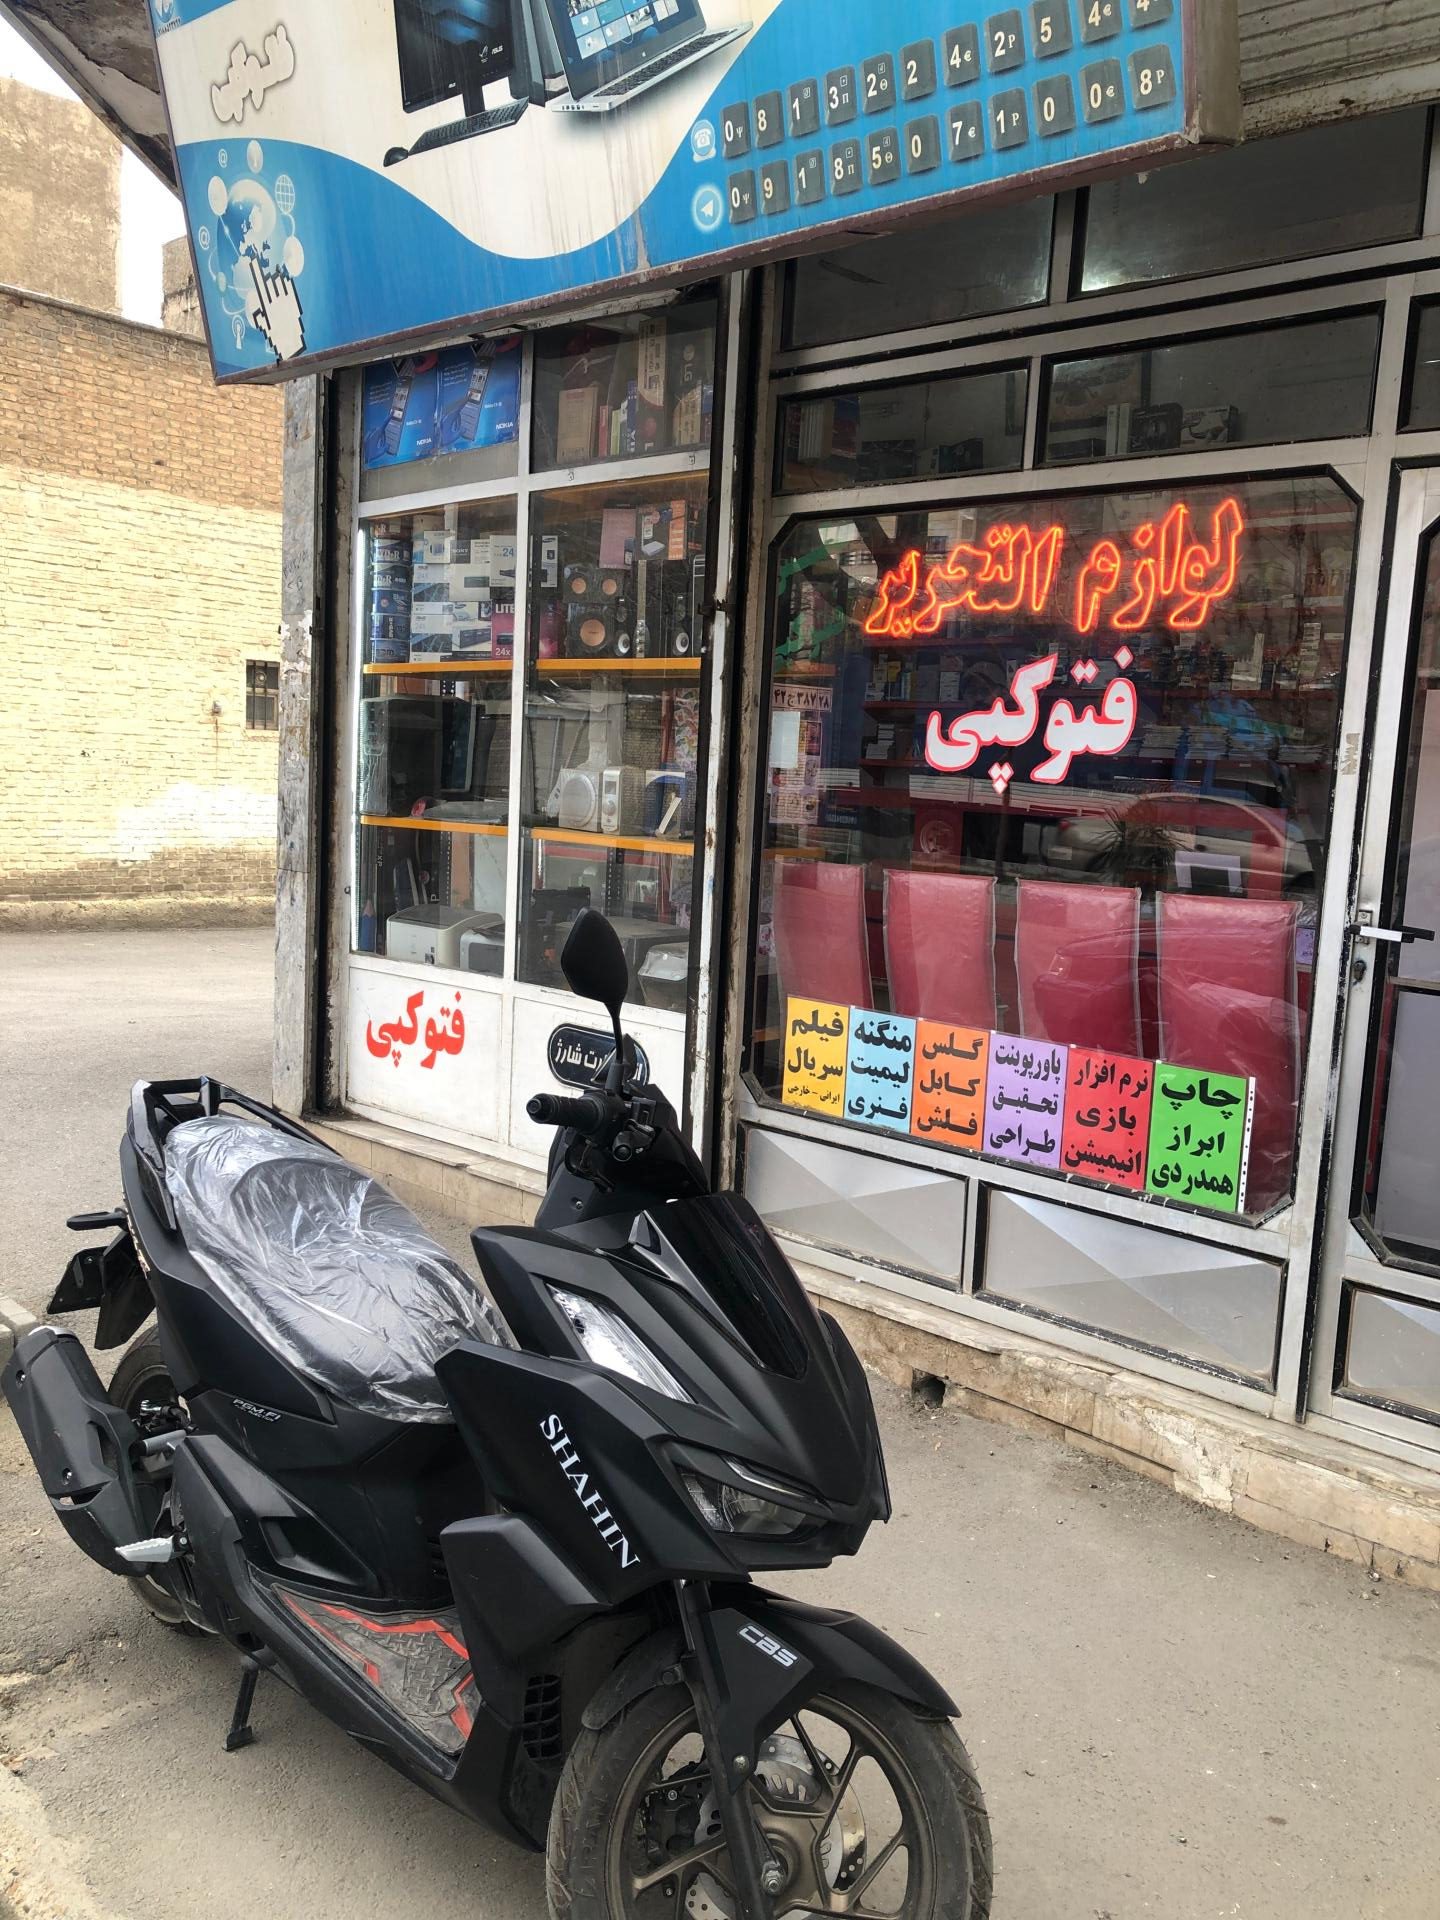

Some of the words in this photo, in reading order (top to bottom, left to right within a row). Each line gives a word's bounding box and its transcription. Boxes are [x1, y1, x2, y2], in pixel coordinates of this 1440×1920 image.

[864, 522, 1065, 636] التحریر
[1076, 498, 1245, 633] لوازم
[792, 1009, 844, 1041] فیلم
[854, 1020, 911, 1052] منگنه
[555, 1037, 583, 1065] شارژ
[922, 1032, 983, 1060] گلس
[787, 1046, 843, 1080] سریال
[850, 1056, 910, 1088] لیمیت
[1073, 1058, 1116, 1089] افزار
[919, 1069, 981, 1097] کابل
[1119, 1069, 1149, 1098] نرم
[1161, 1077, 1242, 1120] چاپ
[848, 1096, 908, 1119] فنری
[992, 1085, 1059, 1115] تحقیق
[916, 1106, 978, 1136] فلش
[1075, 1105, 1137, 1136] بازی
[990, 1123, 1056, 1157] طراحی
[1166, 1124, 1226, 1158] ابراز
[1064, 1140, 1142, 1178] انیمیشن
[1151, 1162, 1234, 1196] همدردی
[539, 1414, 641, 1569] SHAHIN
[738, 1625, 798, 1667] CBS
